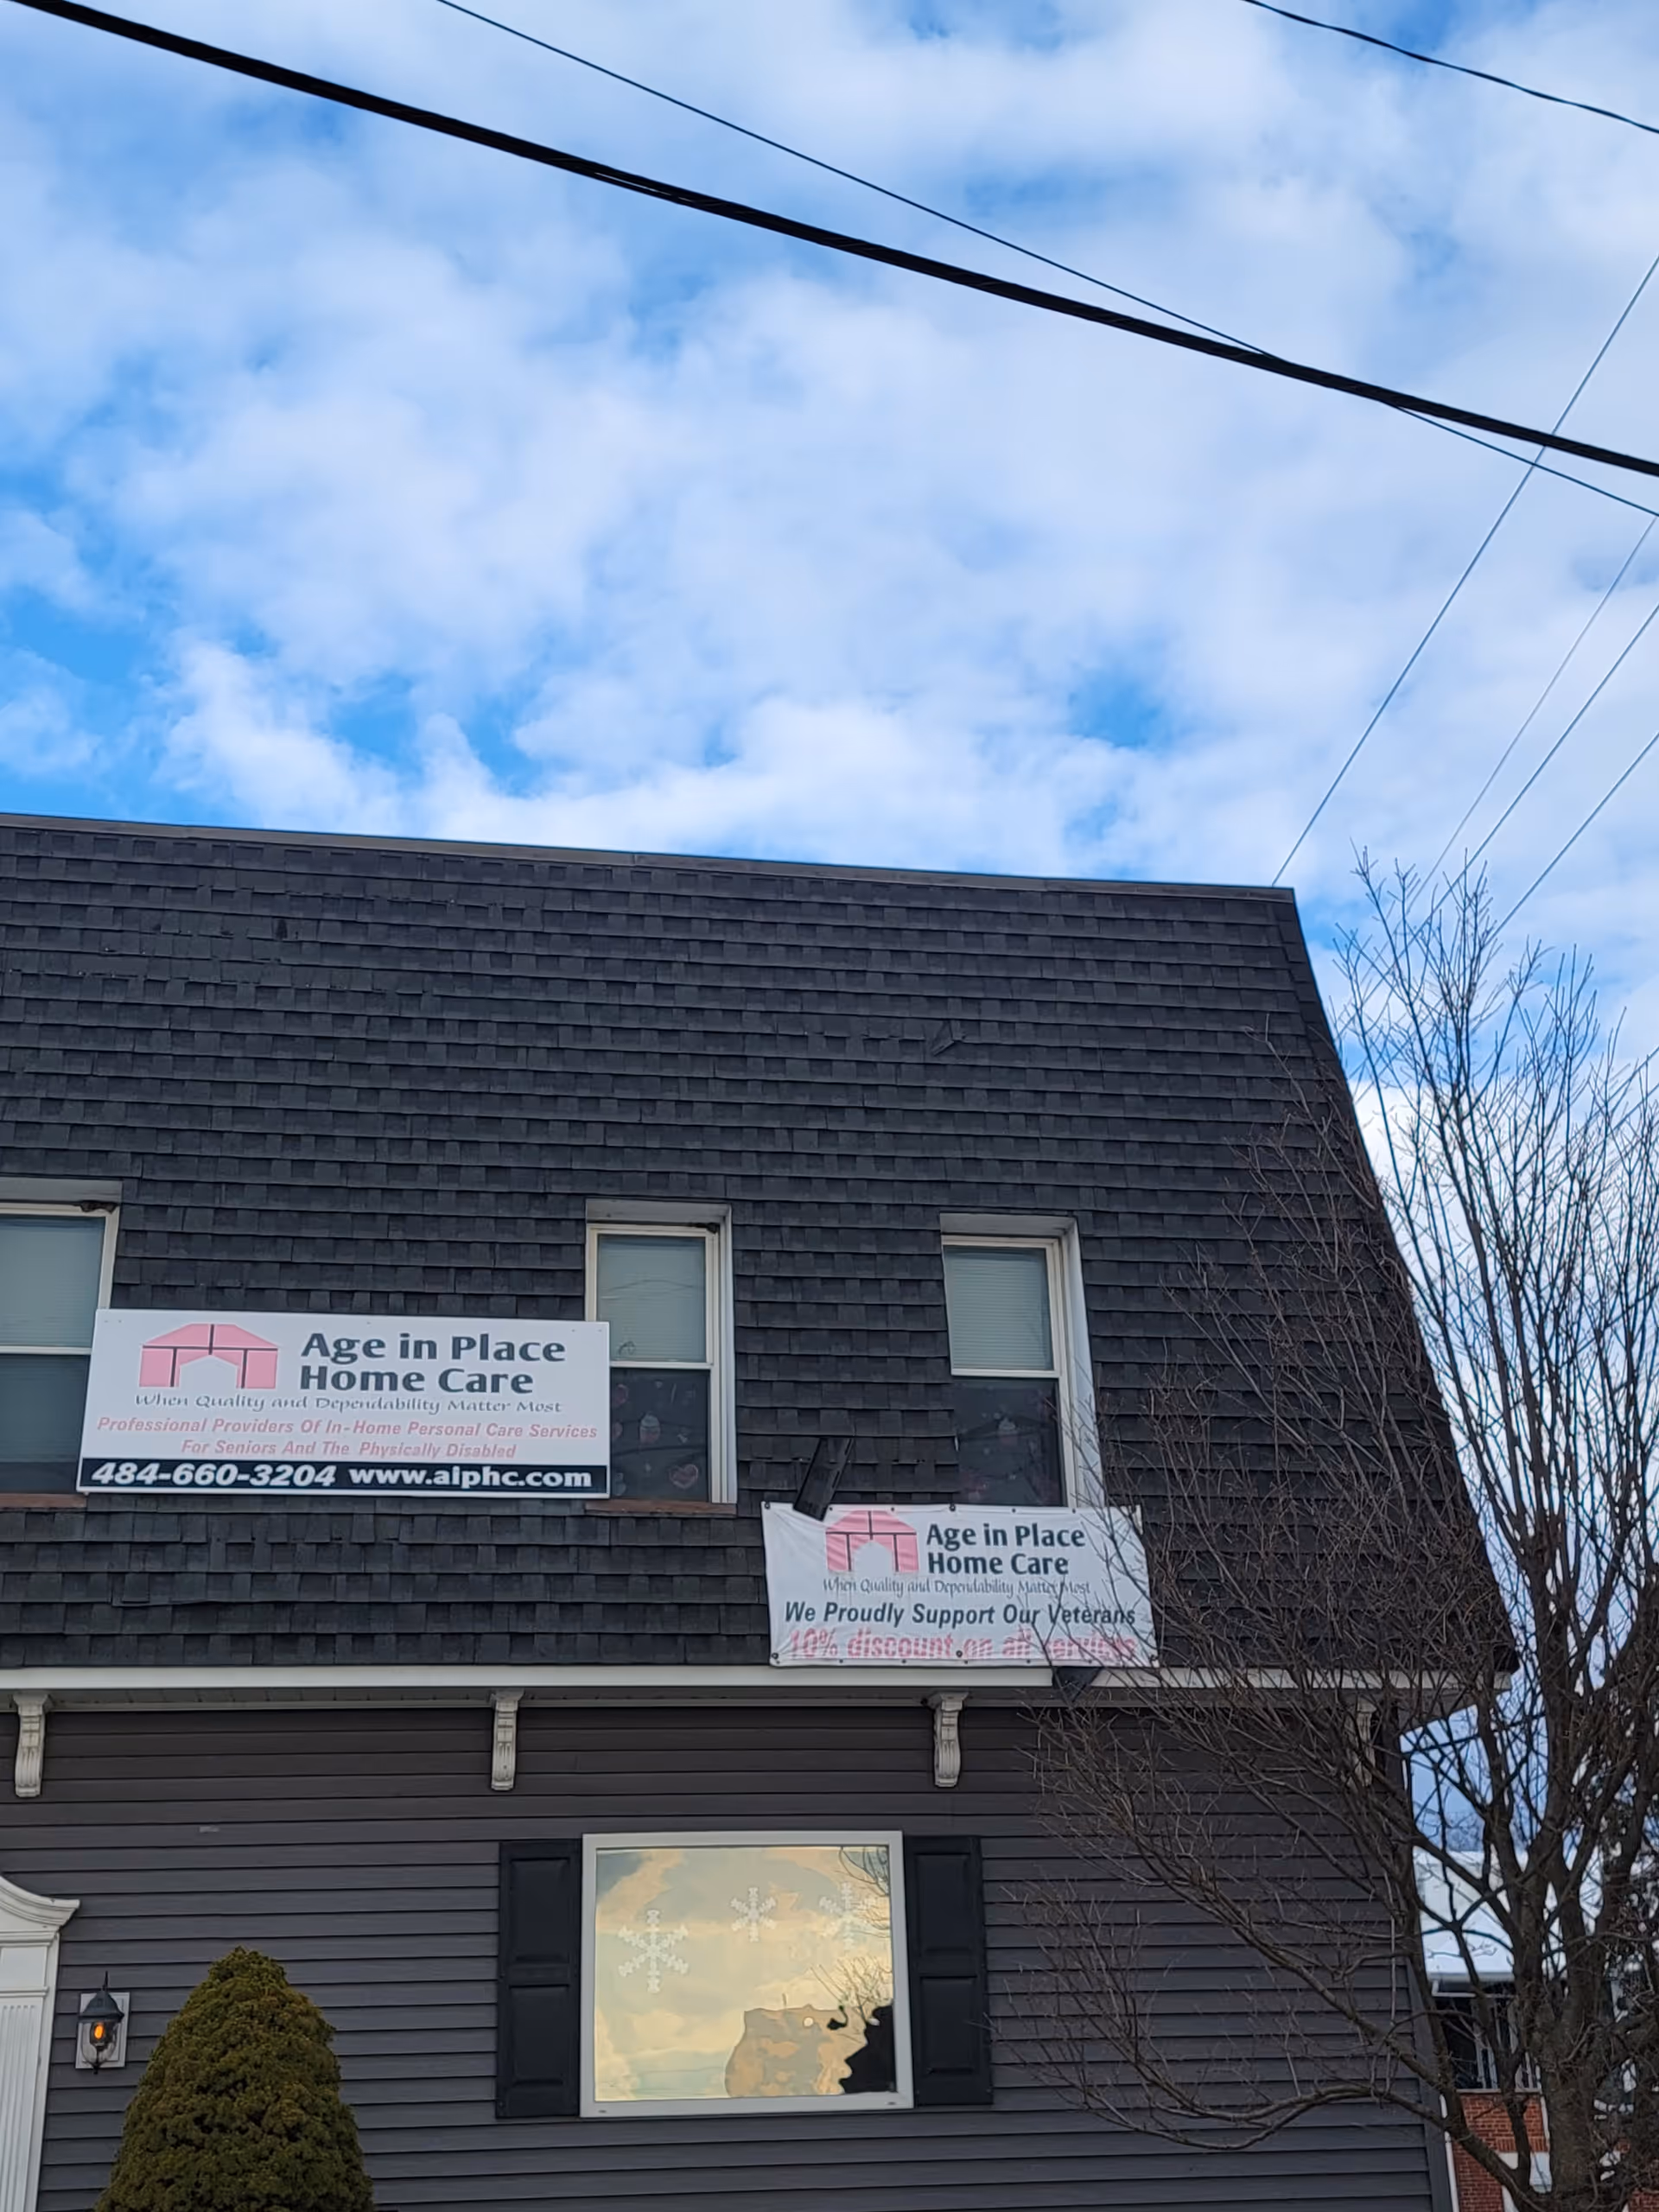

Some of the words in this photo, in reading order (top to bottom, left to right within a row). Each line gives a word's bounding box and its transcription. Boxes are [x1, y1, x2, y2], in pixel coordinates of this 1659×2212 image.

[301, 1332, 386, 1365] Age
[398, 1332, 437, 1360] in
[451, 1333, 566, 1362] Place
[300, 1365, 425, 1392] Home
[438, 1368, 533, 1394] Care
[136, 1393, 188, 1407] When
[196, 1394, 264, 1413] Quality
[271, 1396, 308, 1408] and
[315, 1396, 440, 1415] Dependability
[447, 1400, 512, 1412] Matter
[516, 1401, 563, 1413] Most
[97, 1417, 207, 1432] Professional
[212, 1418, 294, 1433] Providers
[300, 1419, 323, 1433] Of
[326, 1420, 402, 1435] In-Home
[407, 1421, 481, 1437] Personal
[486, 1423, 524, 1438] Care
[528, 1424, 598, 1439] Services
[181, 1439, 210, 1453] For
[214, 1440, 277, 1455] Seniors
[282, 1440, 316, 1456] And
[321, 1441, 350, 1455] The
[359, 1442, 442, 1459] Physically
[446, 1444, 518, 1459] Disabled
[91, 1462, 337, 1487] 484-660-3204
[926, 1523, 976, 1552] Age
[983, 1523, 1007, 1547] in
[1015, 1523, 1085, 1548] Place
[928, 1552, 1003, 1575] Home
[1011, 1553, 1069, 1575] Care
[823, 1577, 857, 1592] When
[861, 1578, 904, 1599] Quality
[907, 1580, 930, 1593] and
[935, 1580, 1014, 1599] Dependability
[785, 1601, 816, 1622] We
[823, 1602, 904, 1628] Proudly
[912, 1603, 995, 1629] Support
[1003, 1604, 1040, 1624] Our
[1048, 1604, 1135, 1625] Veterans
[790, 1627, 838, 1658] 10%
[847, 1626, 953, 1658] discount
[963, 1638, 993, 1658] on
